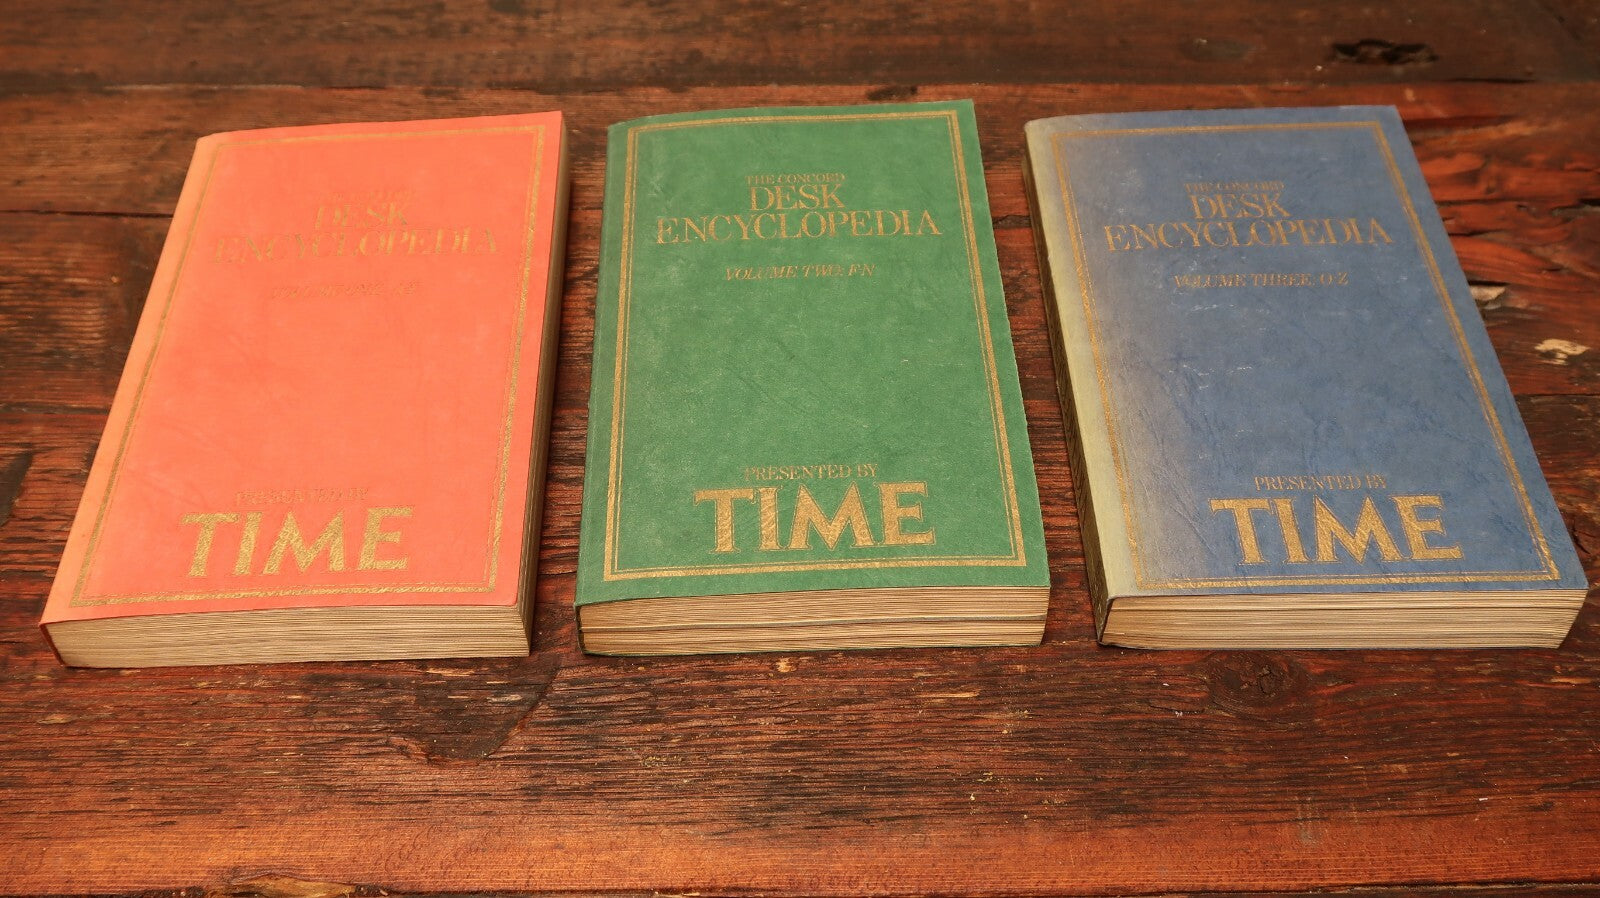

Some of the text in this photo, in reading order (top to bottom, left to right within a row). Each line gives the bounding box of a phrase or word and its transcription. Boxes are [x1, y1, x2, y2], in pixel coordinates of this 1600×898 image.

[778, 173, 846, 184] CONCORD
[750, 184, 846, 211] DESK
[1188, 193, 1291, 219] DESK
[655, 209, 943, 244] ENCYCLOPEDIA
[1104, 217, 1396, 251] ENCYCLOPEDIA
[725, 265, 800, 281] VOLUME
[1174, 274, 1247, 288] VOLUME
[744, 464, 878, 481] PRESENTED BY
[1254, 474, 1387, 490] PRESENTED BY
[693, 481, 936, 554] TIME
[1208, 494, 1465, 565] TIME
[181, 506, 414, 577] TIME
